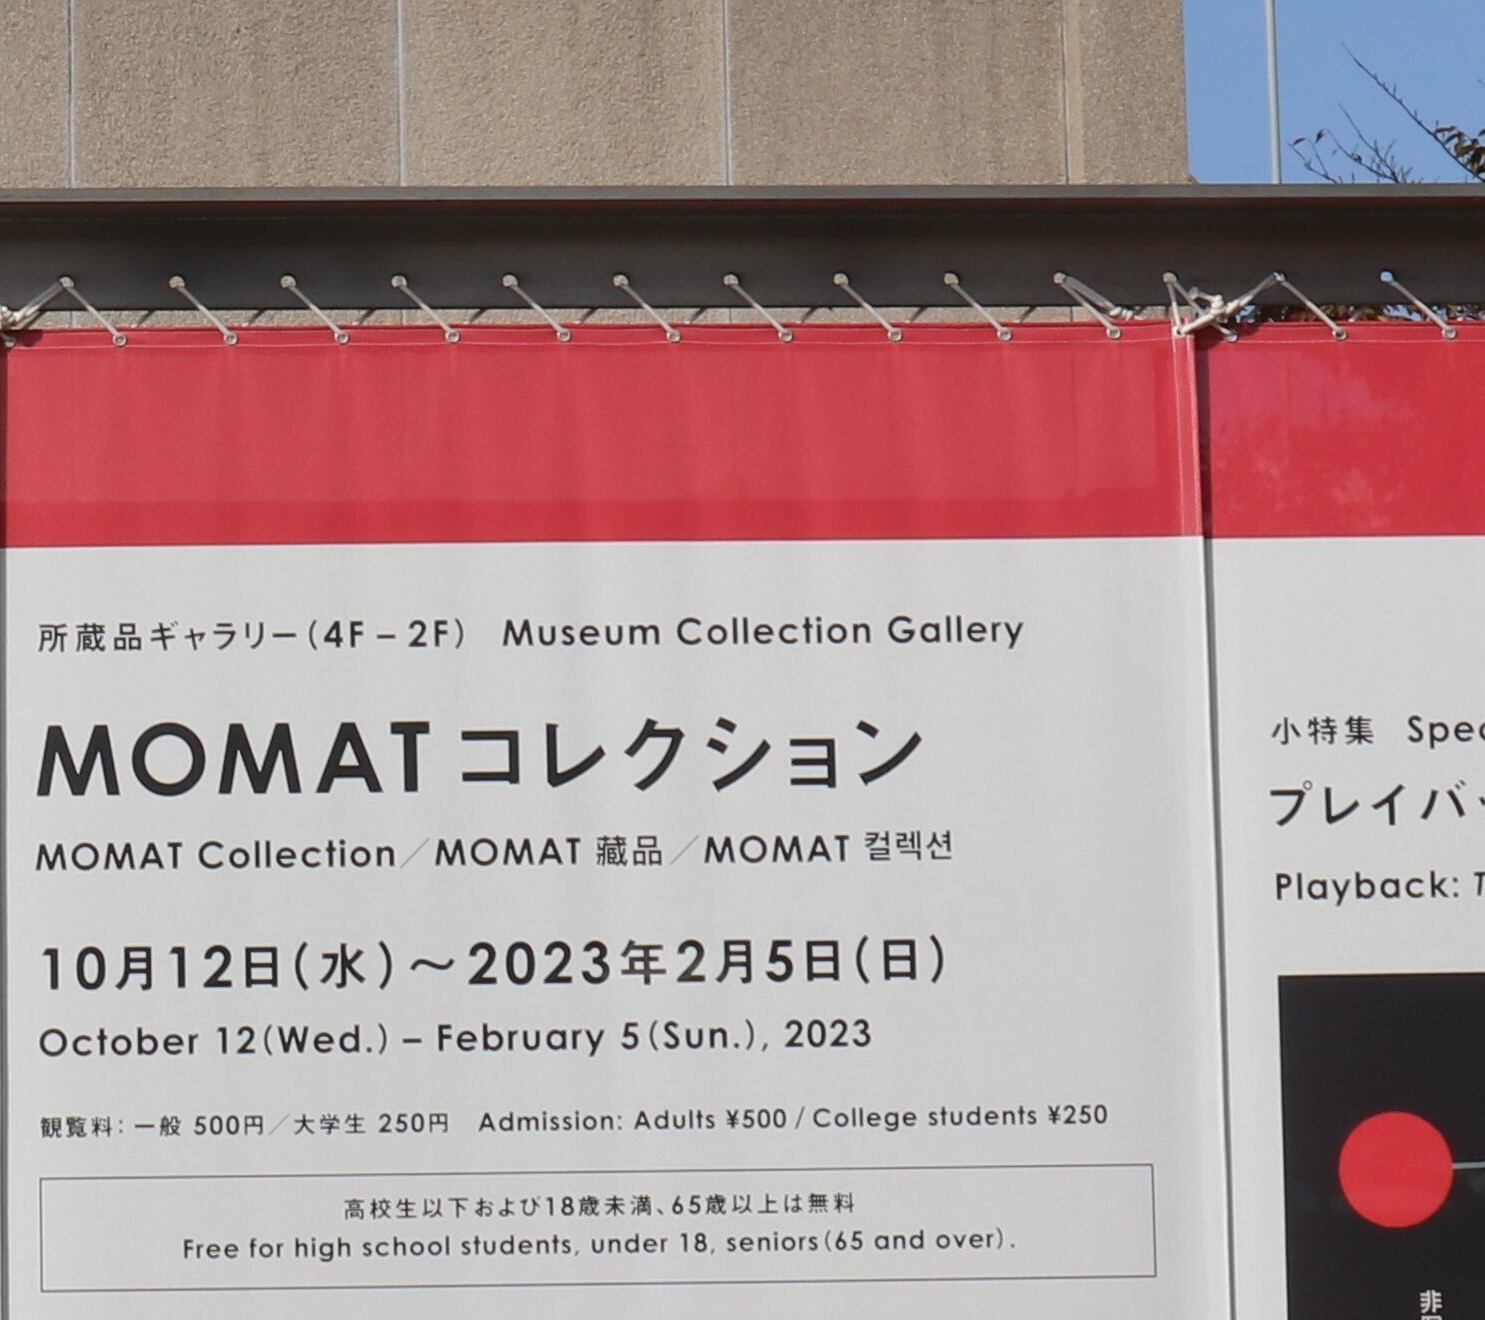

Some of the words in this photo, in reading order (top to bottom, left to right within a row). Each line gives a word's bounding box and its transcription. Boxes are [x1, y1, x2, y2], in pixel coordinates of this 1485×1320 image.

[502, 618, 660, 647] Museum
[676, 616, 871, 646] Collection
[887, 614, 1024, 650] Gallery
[1271, 715, 1374, 746] 小特集
[35, 841, 183, 871] MOMAT
[864, 829, 952, 862] 컬렉션
[1275, 870, 1459, 907] Playback:
[39, 1026, 199, 1057] October
[437, 1022, 605, 1058] February
[784, 1018, 871, 1048] 2023
[378, 1112, 449, 1134] 250円
[478, 1110, 622, 1132] Admission:
[634, 1109, 716, 1130] Adults
[726, 1108, 787, 1129] ¥500
[812, 1107, 918, 1133] College
[928, 1105, 1037, 1127] students
[1047, 1104, 1108, 1125] ¥250
[183, 1238, 239, 1259] Free
[249, 1237, 284, 1259] for
[294, 1237, 351, 1263] high
[362, 1235, 450, 1258] school
[461, 1234, 579, 1256] students,
[591, 1233, 668, 1254] under
[680, 1232, 715, 1254] 18,
[874, 1229, 925, 1251] and
